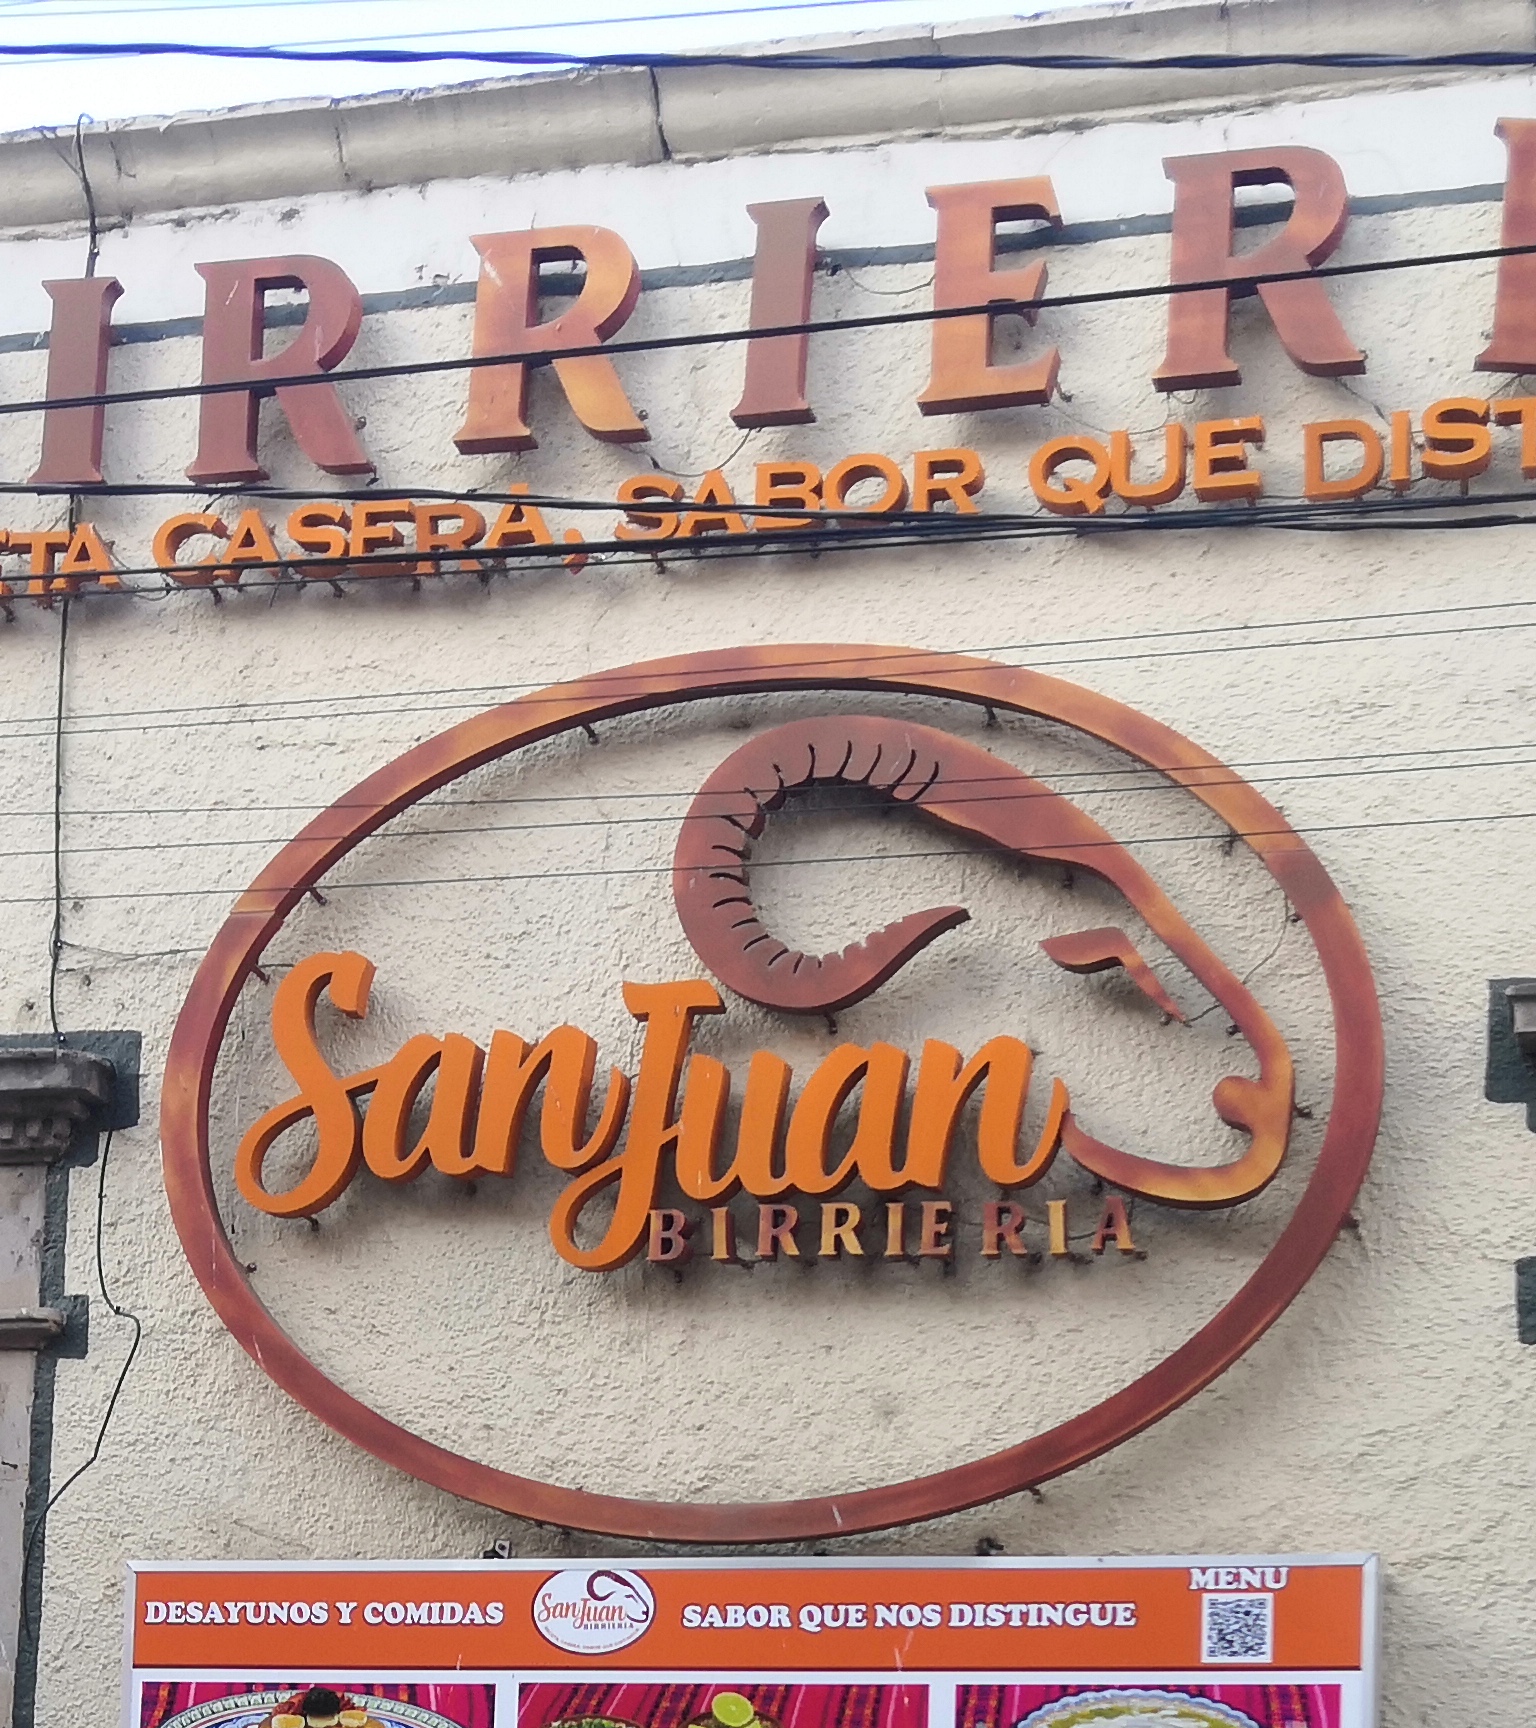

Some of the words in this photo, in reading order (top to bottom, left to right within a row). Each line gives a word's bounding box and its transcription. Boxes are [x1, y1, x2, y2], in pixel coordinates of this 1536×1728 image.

[614, 446, 986, 541] SABOR
[1028, 415, 1264, 517] QUE
[646, 1196, 1137, 1262] BIRRIERIA
[1189, 1566, 1290, 1592] MENU
[144, 1600, 331, 1626] DESAYUNOS
[335, 1601, 361, 1625] Y
[363, 1601, 505, 1627] COMIDAS
[682, 1603, 792, 1629] SABOR
[799, 1604, 868, 1634] QUE
[874, 1603, 942, 1629] NOS
[947, 1602, 1137, 1629] DISTINGUE
